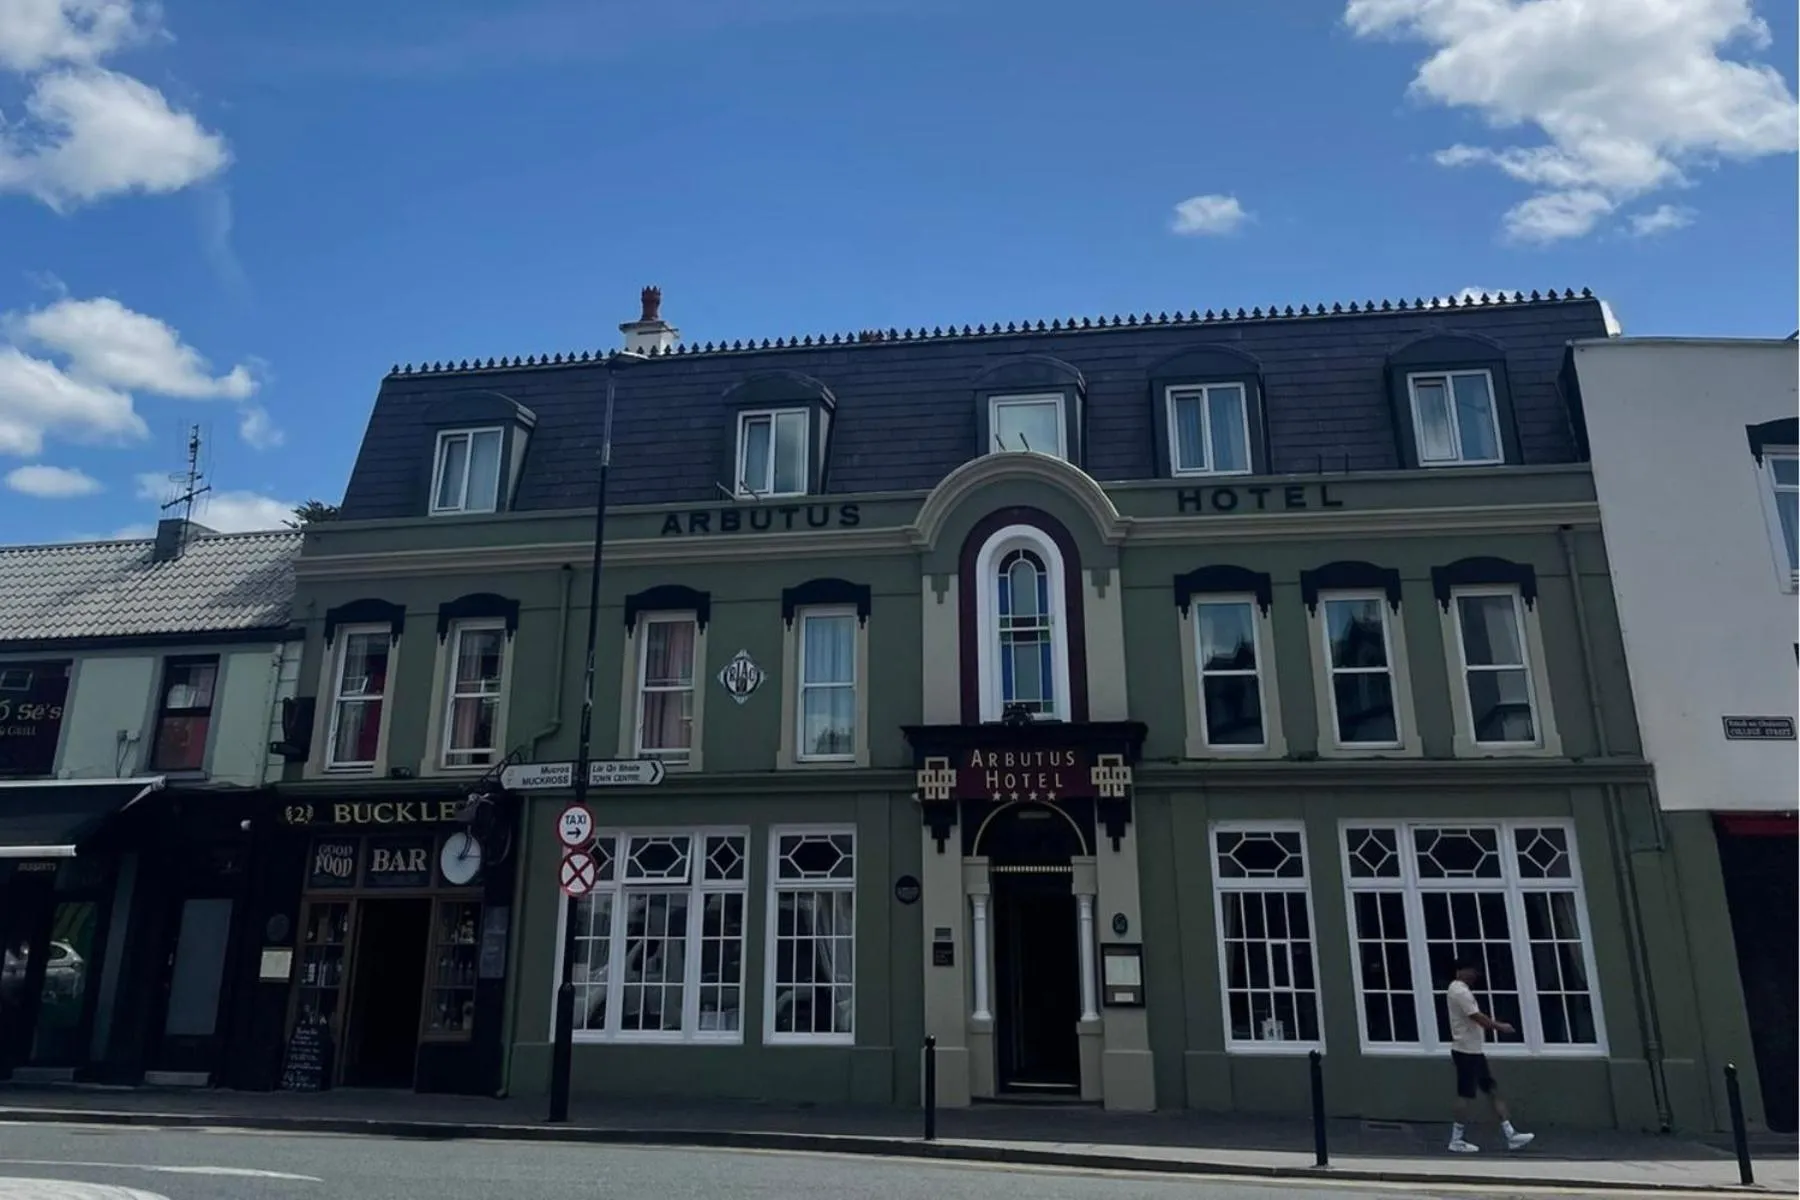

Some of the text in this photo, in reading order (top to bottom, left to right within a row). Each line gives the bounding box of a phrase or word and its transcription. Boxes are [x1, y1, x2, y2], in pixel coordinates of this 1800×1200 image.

[661, 485, 1343, 535] ARBUTUS HOTEL
[971, 749, 1075, 768] ARBUTUS
[522, 775, 569, 785] MUCKROSS
[986, 770, 1063, 789] HOTEL
[334, 802, 458, 823] BUCKLE
[565, 814, 587, 825] TAXI
[318, 844, 353, 857] GOOD
[370, 848, 428, 872] BAR
[313, 854, 353, 878] FOOD
